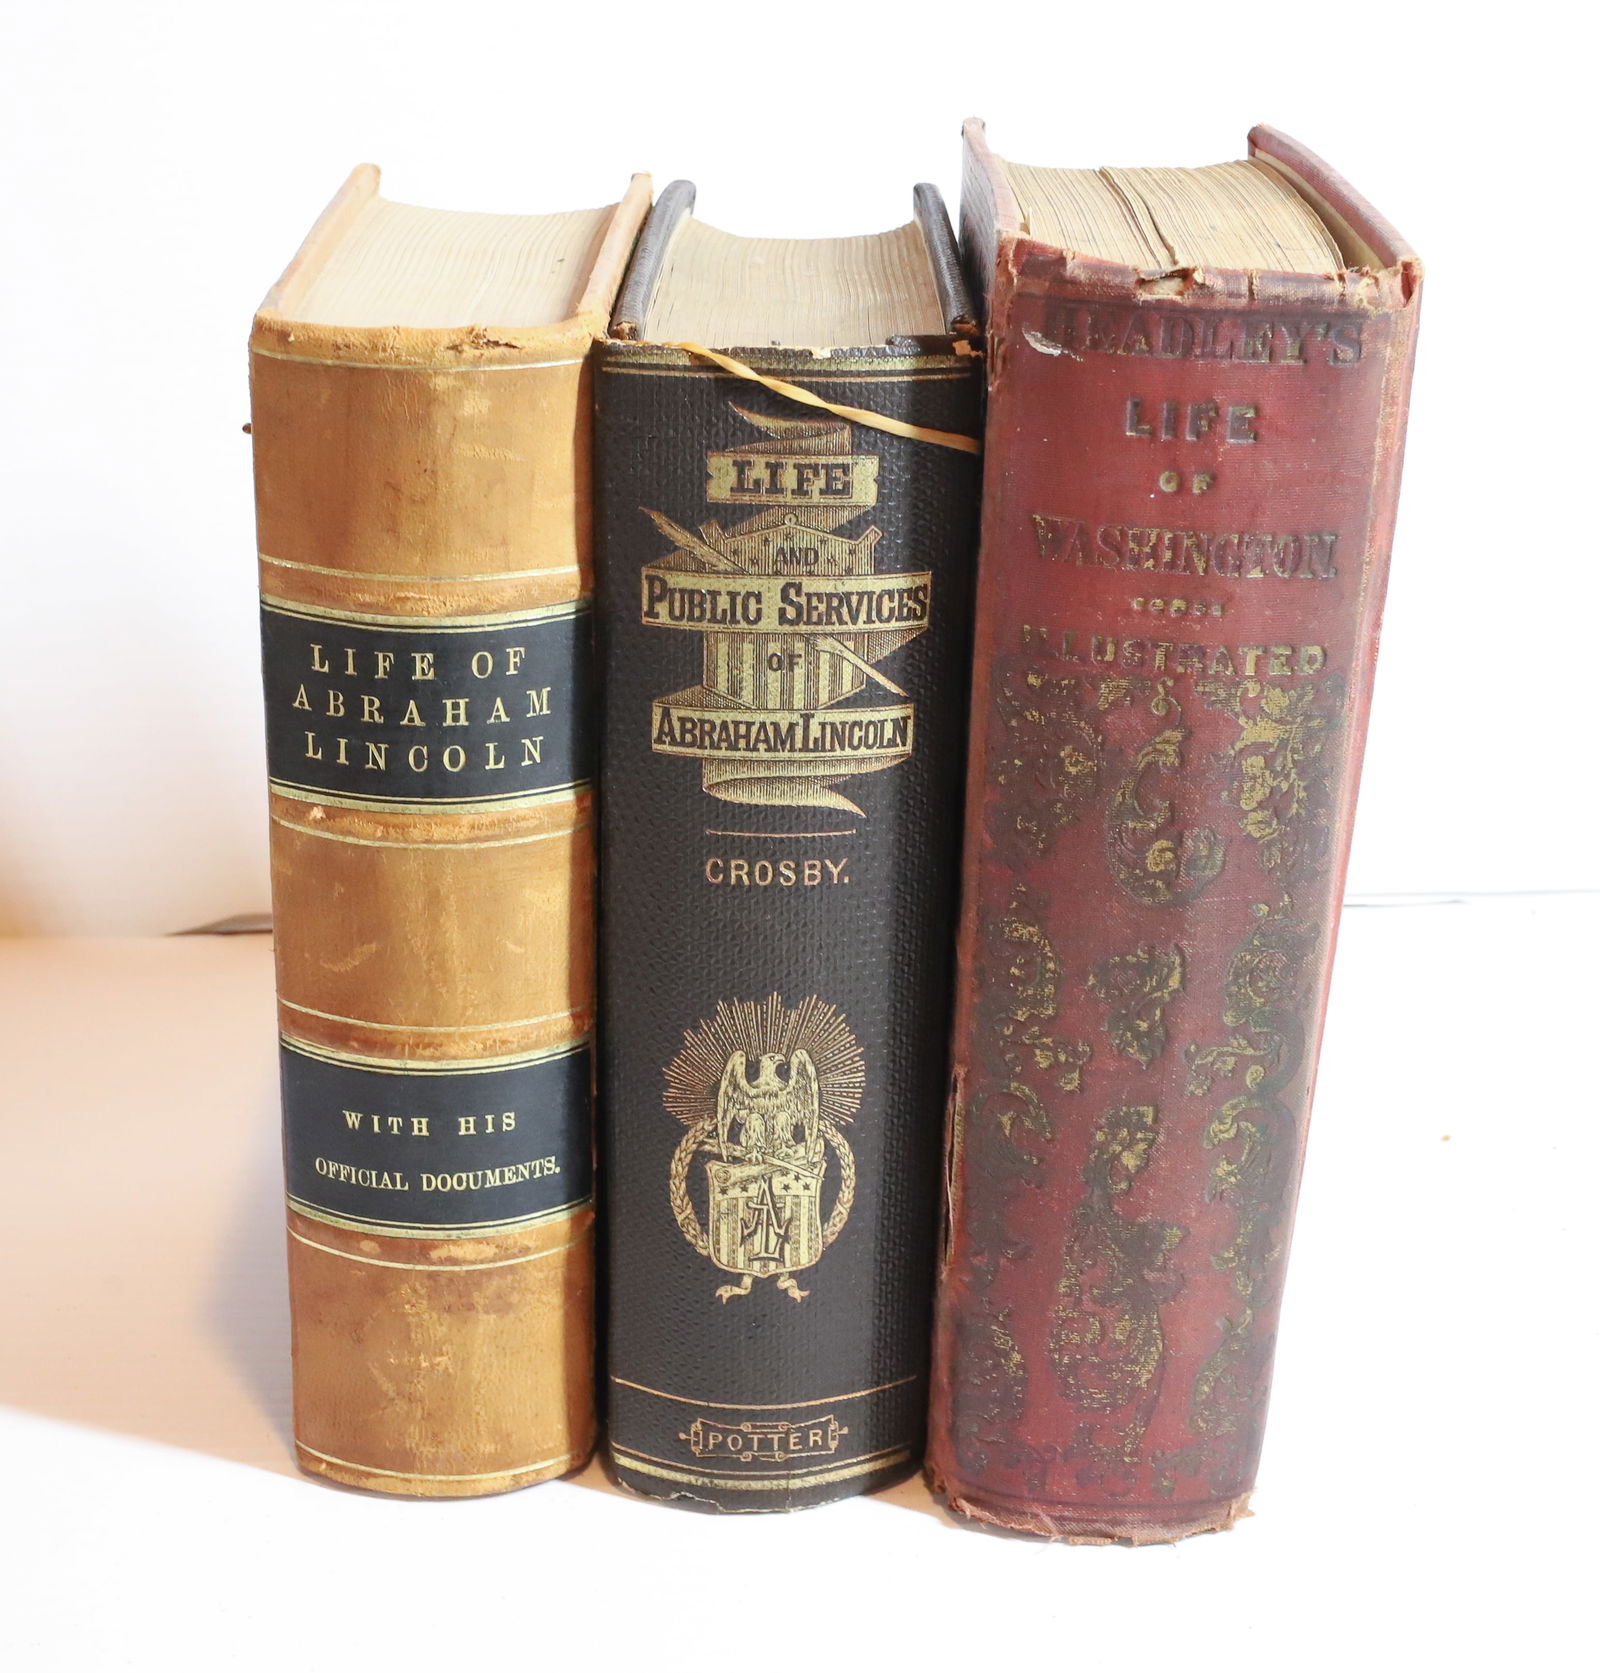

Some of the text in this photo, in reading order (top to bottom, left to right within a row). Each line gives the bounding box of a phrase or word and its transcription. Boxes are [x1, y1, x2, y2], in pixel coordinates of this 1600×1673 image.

[1125, 399, 1256, 444] LIFE
[730, 459, 851, 496] LIFE
[1158, 471, 1215, 494] OF
[775, 547, 819, 566] AND
[643, 575, 929, 627] PUBLIC SERVICES
[310, 643, 526, 681] LIFE OF
[768, 652, 802, 672] OF
[292, 684, 551, 727] ABRAHAM
[653, 706, 912, 752] ABRAHAM LINCOLN
[305, 731, 544, 772] LINCOLN
[705, 857, 850, 886] CROSBY.
[342, 1110, 516, 1137] WITH HIS
[315, 1156, 561, 1192] OFFICIAL DOCUMENTS.
[708, 1429, 823, 1451] POTTER
